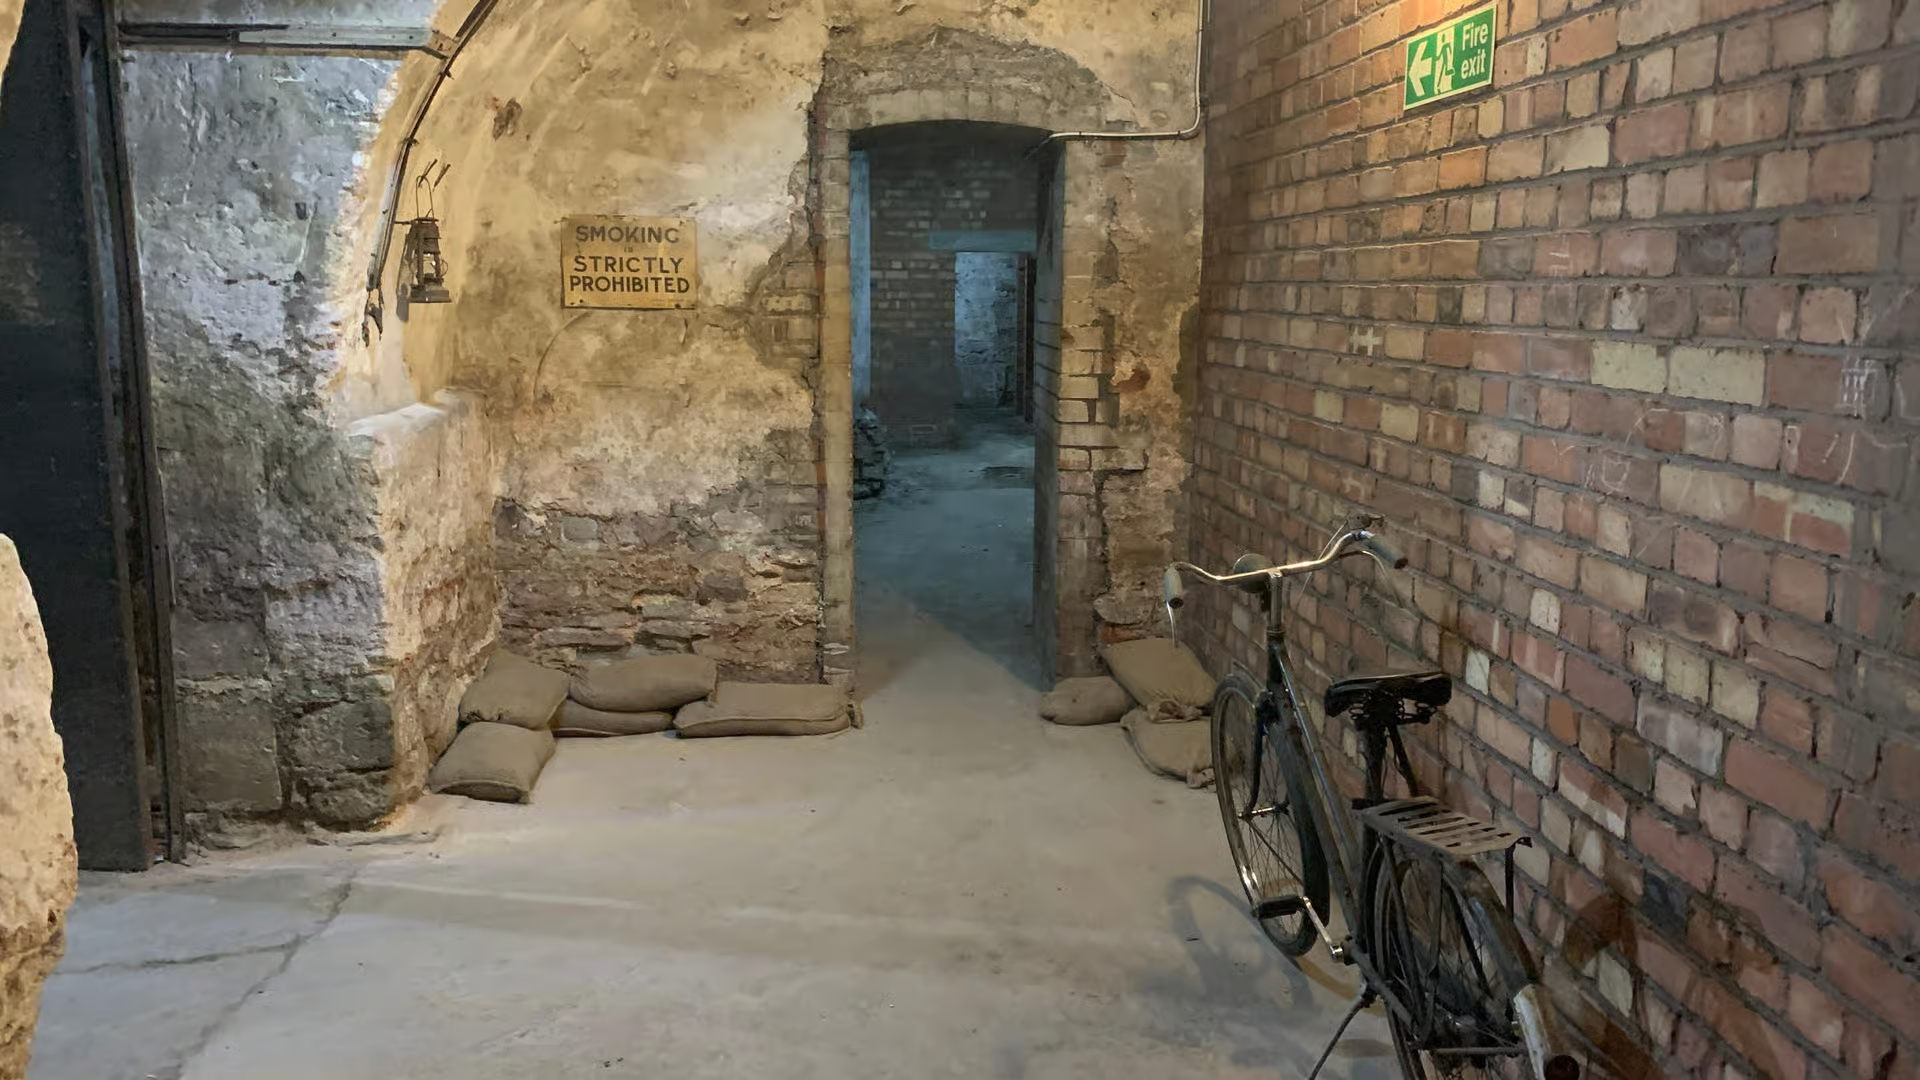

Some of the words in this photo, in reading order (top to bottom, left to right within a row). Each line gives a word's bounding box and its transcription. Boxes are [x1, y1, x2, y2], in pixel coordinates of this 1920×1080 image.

[1462, 22, 1489, 51] Fire
[1461, 49, 1486, 80] exit
[575, 225, 680, 243] SMOKING
[574, 255, 684, 274] STRICTLY
[569, 275, 690, 294] PROHIBITED
